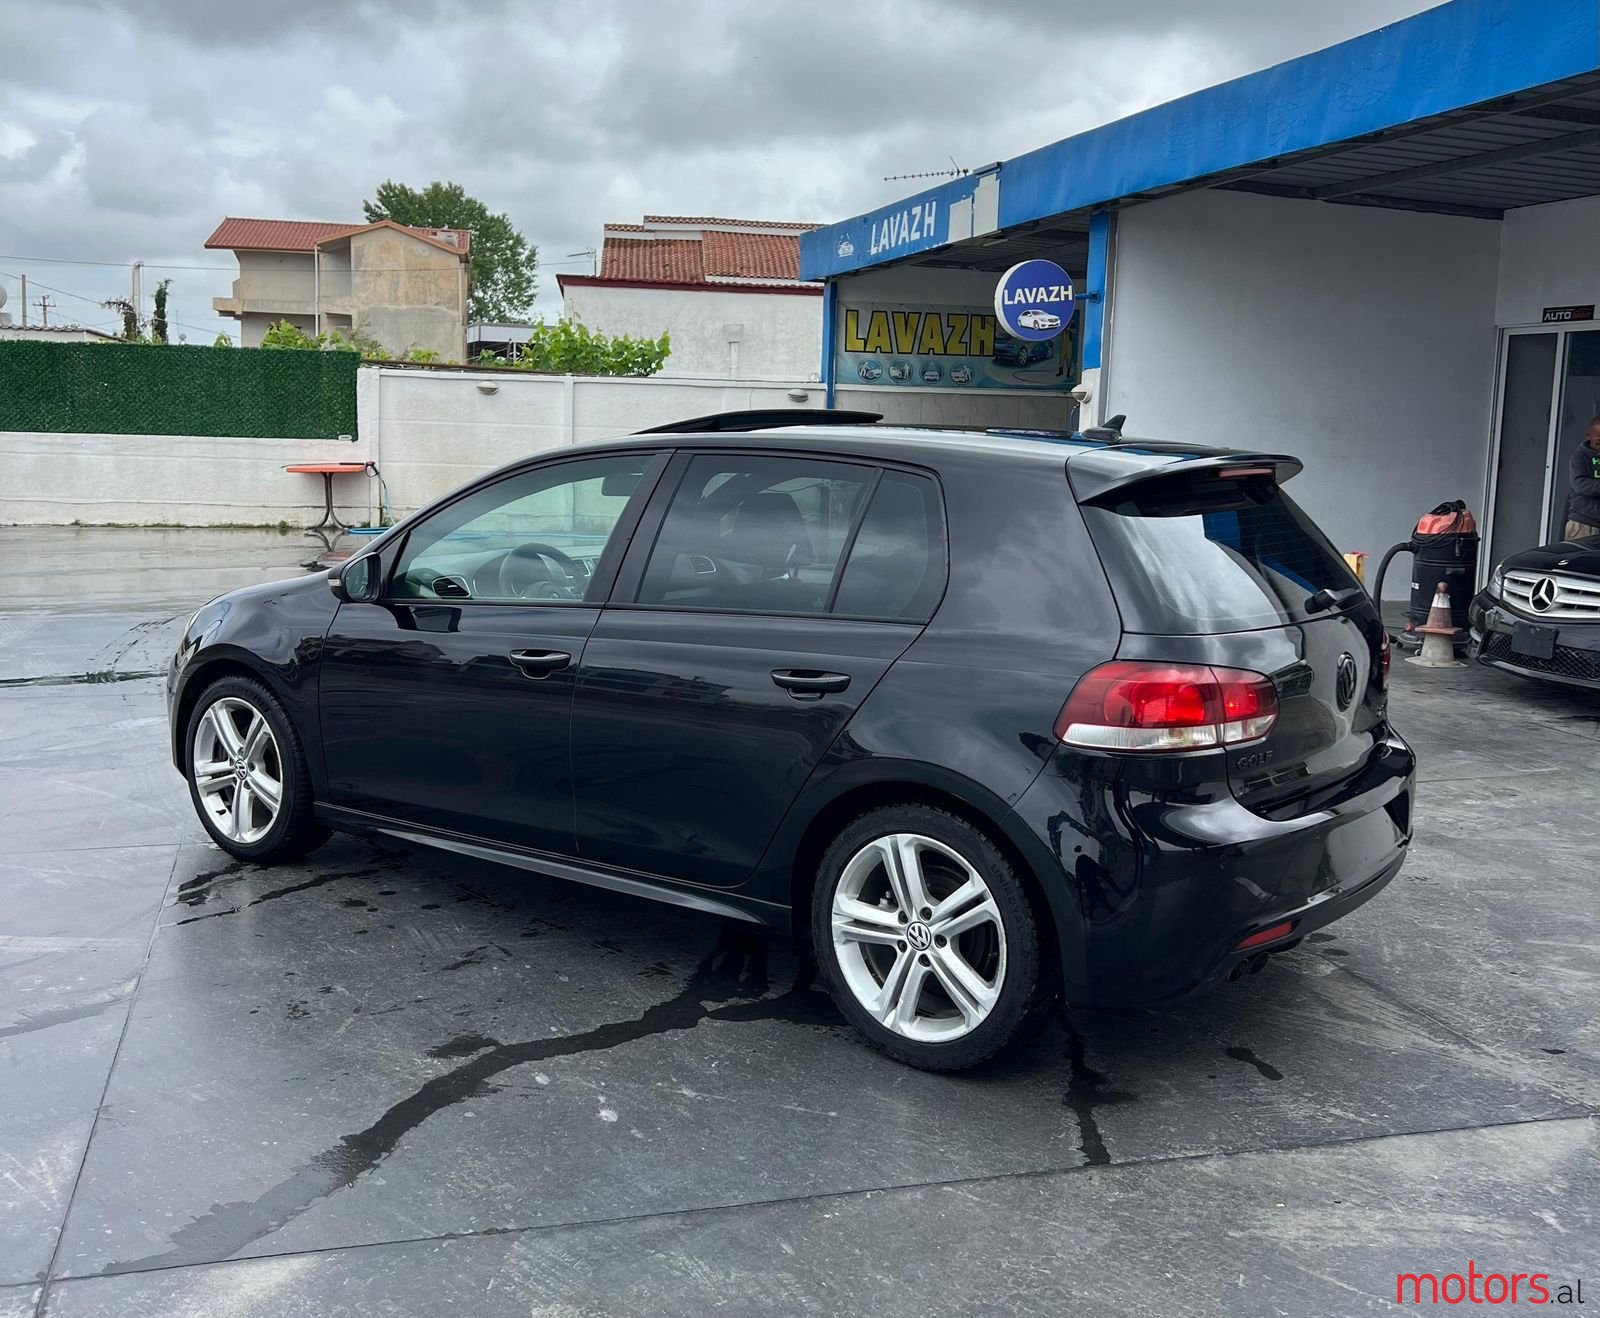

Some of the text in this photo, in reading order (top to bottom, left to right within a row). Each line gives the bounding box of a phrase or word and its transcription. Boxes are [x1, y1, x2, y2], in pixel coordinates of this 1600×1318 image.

[870, 201, 937, 256] LAVAZH
[1004, 285, 1073, 305] LAVAZH
[1544, 311, 1572, 321] AUTO
[844, 309, 996, 357] LAVAZH
[1235, 750, 1273, 769] GOLF
